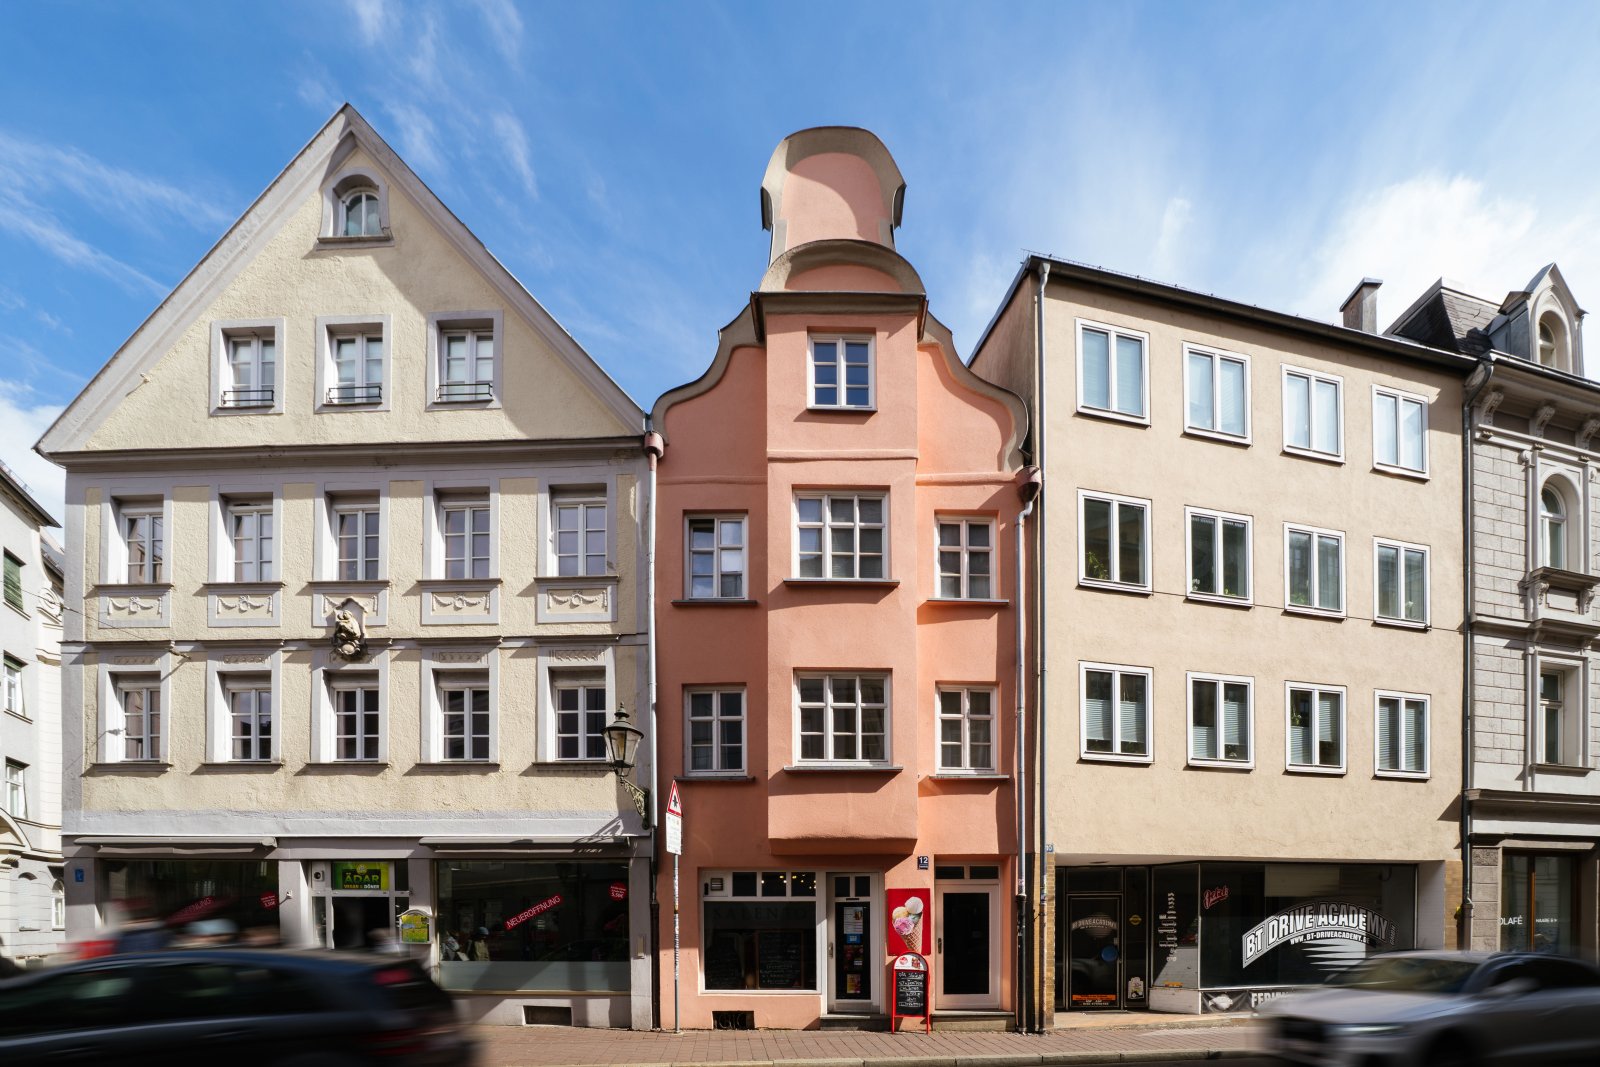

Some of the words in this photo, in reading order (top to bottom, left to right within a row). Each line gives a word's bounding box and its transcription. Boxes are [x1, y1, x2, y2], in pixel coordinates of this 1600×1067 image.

[919, 856, 928, 864] 12
[344, 872, 380, 884] ÄDAR
[1246, 927, 1264, 960] BT
[1268, 904, 1314, 945] DRIVE
[1317, 902, 1388, 941] ACADEMY
